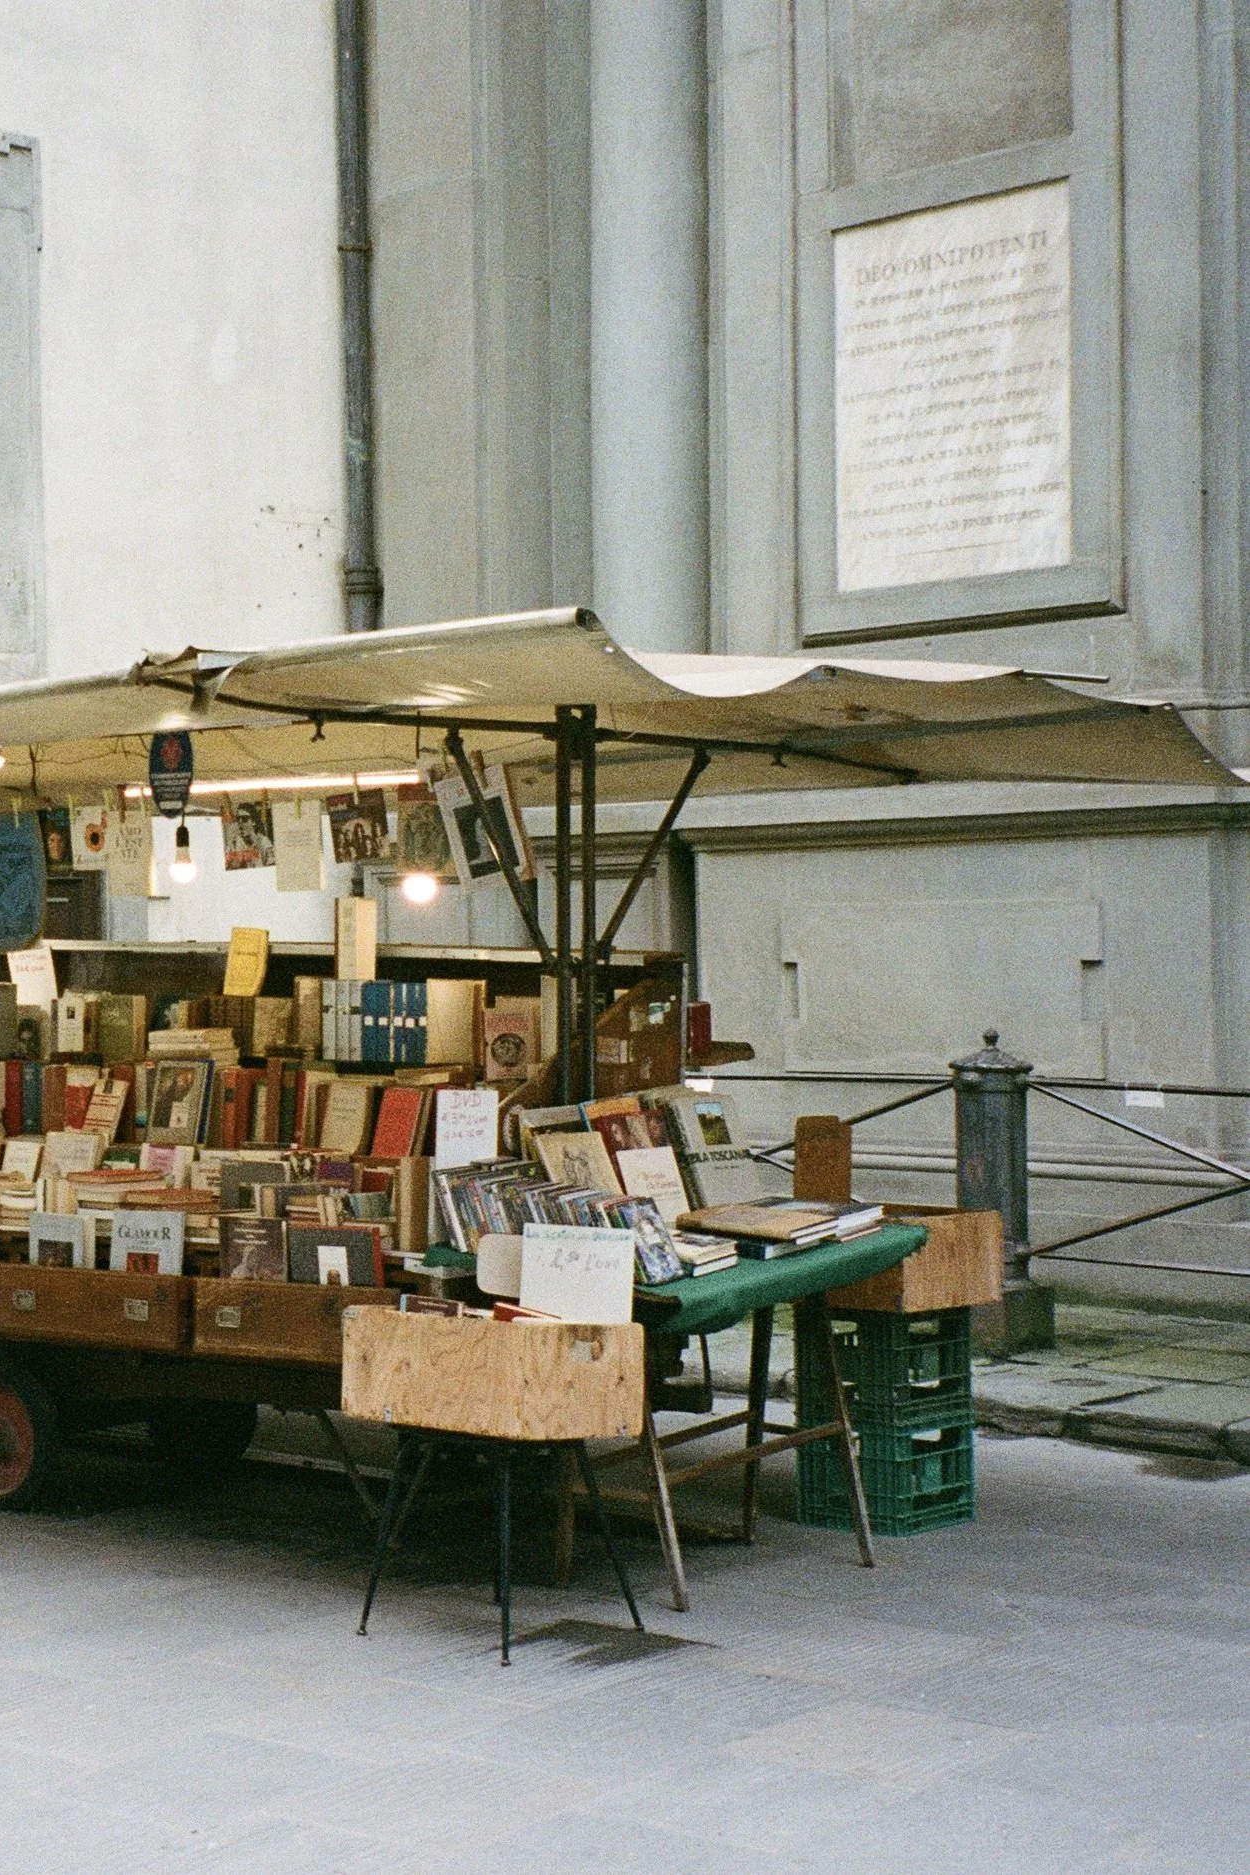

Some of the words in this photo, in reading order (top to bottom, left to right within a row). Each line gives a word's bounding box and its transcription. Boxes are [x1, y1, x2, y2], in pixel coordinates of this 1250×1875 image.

[855, 262, 896, 286] DEO
[449, 1091, 482, 1110] DVD
[117, 1224, 171, 1240] GLAMOUR
